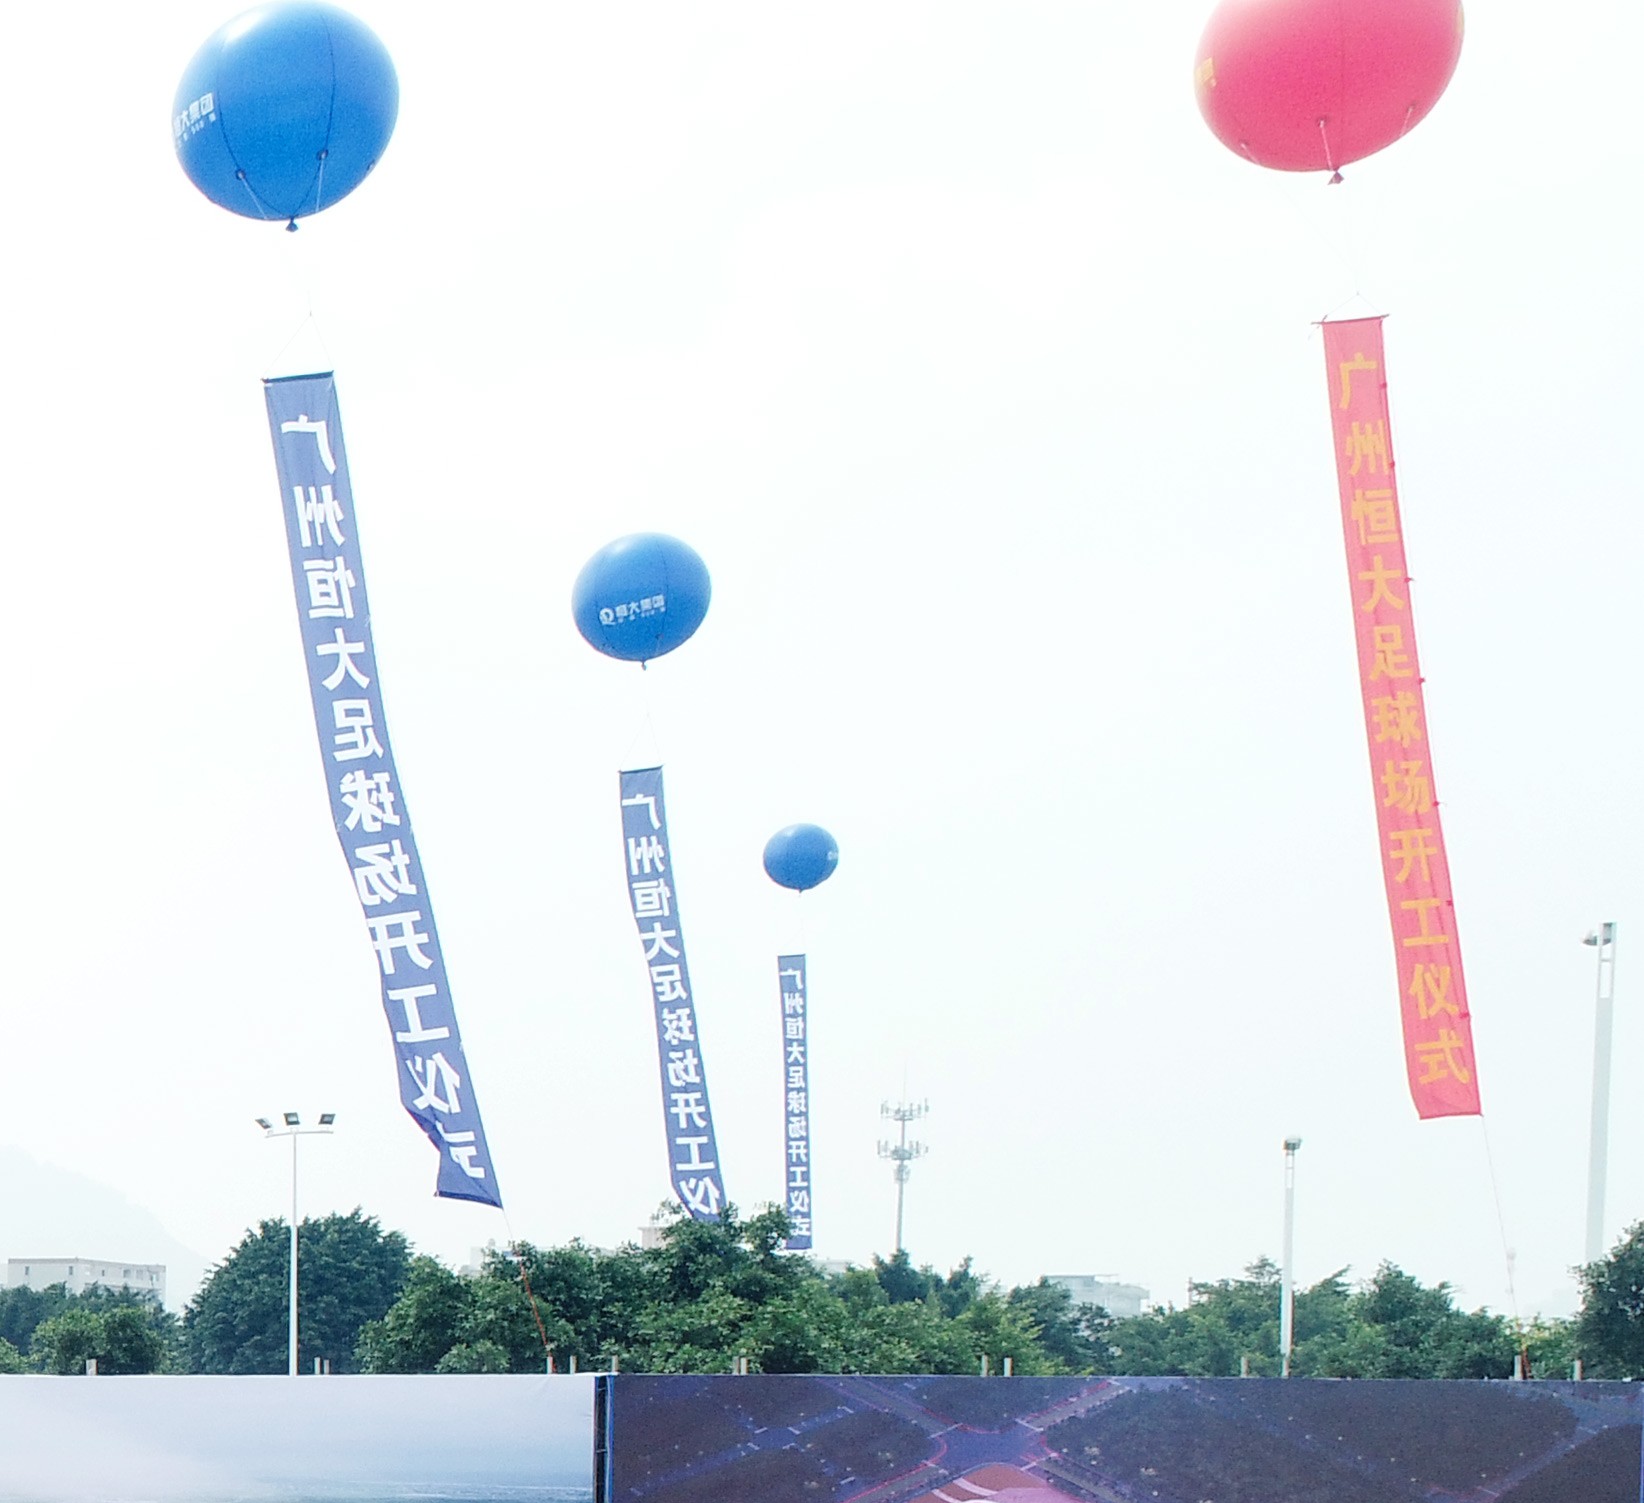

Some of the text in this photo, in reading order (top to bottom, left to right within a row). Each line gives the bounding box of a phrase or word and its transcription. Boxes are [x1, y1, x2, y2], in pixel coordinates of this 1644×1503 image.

[1339, 351, 1471, 1086] 广州恒大足球场开工仪式
